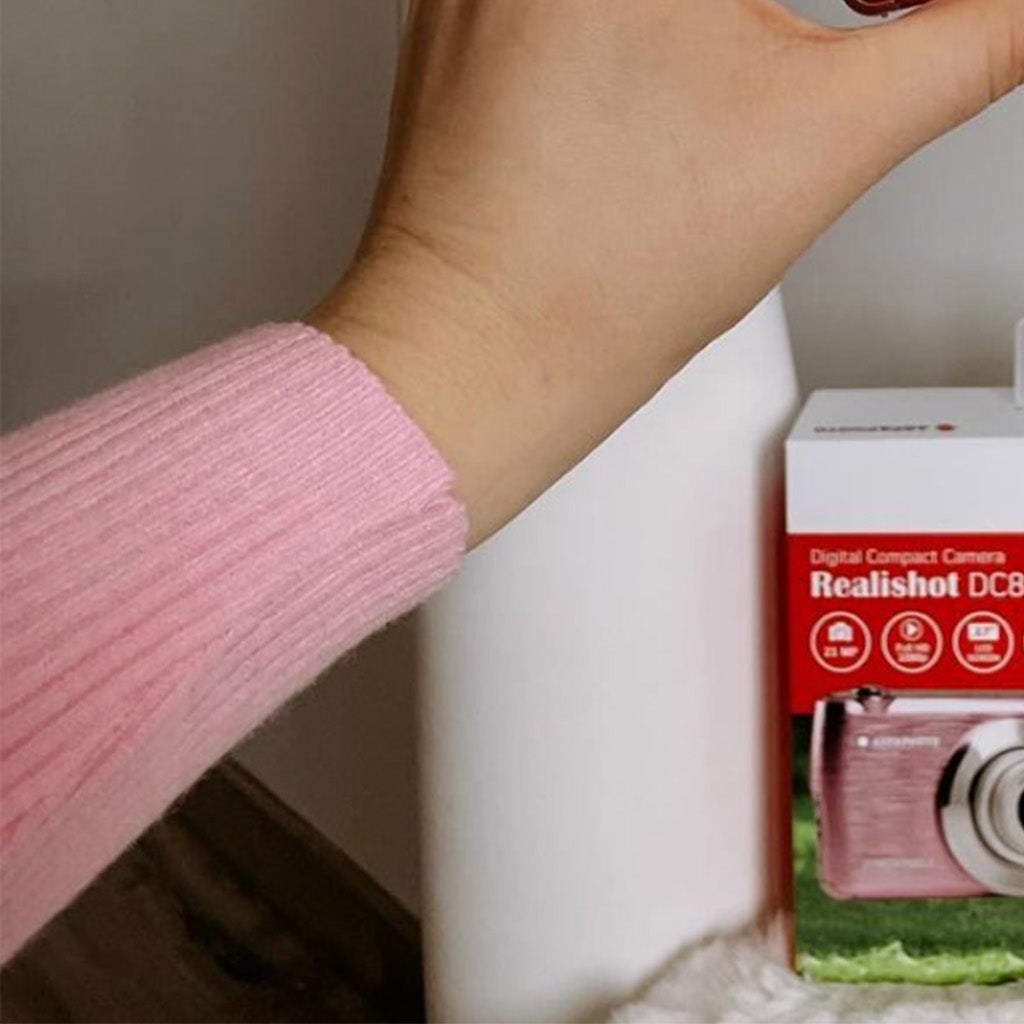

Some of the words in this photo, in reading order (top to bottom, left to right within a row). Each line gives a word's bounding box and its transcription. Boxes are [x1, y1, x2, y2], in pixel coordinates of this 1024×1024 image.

[809, 548, 863, 567] Digital
[865, 548, 938, 566] Compact
[941, 548, 1006, 565] Camera
[809, 570, 960, 599] Realishot
